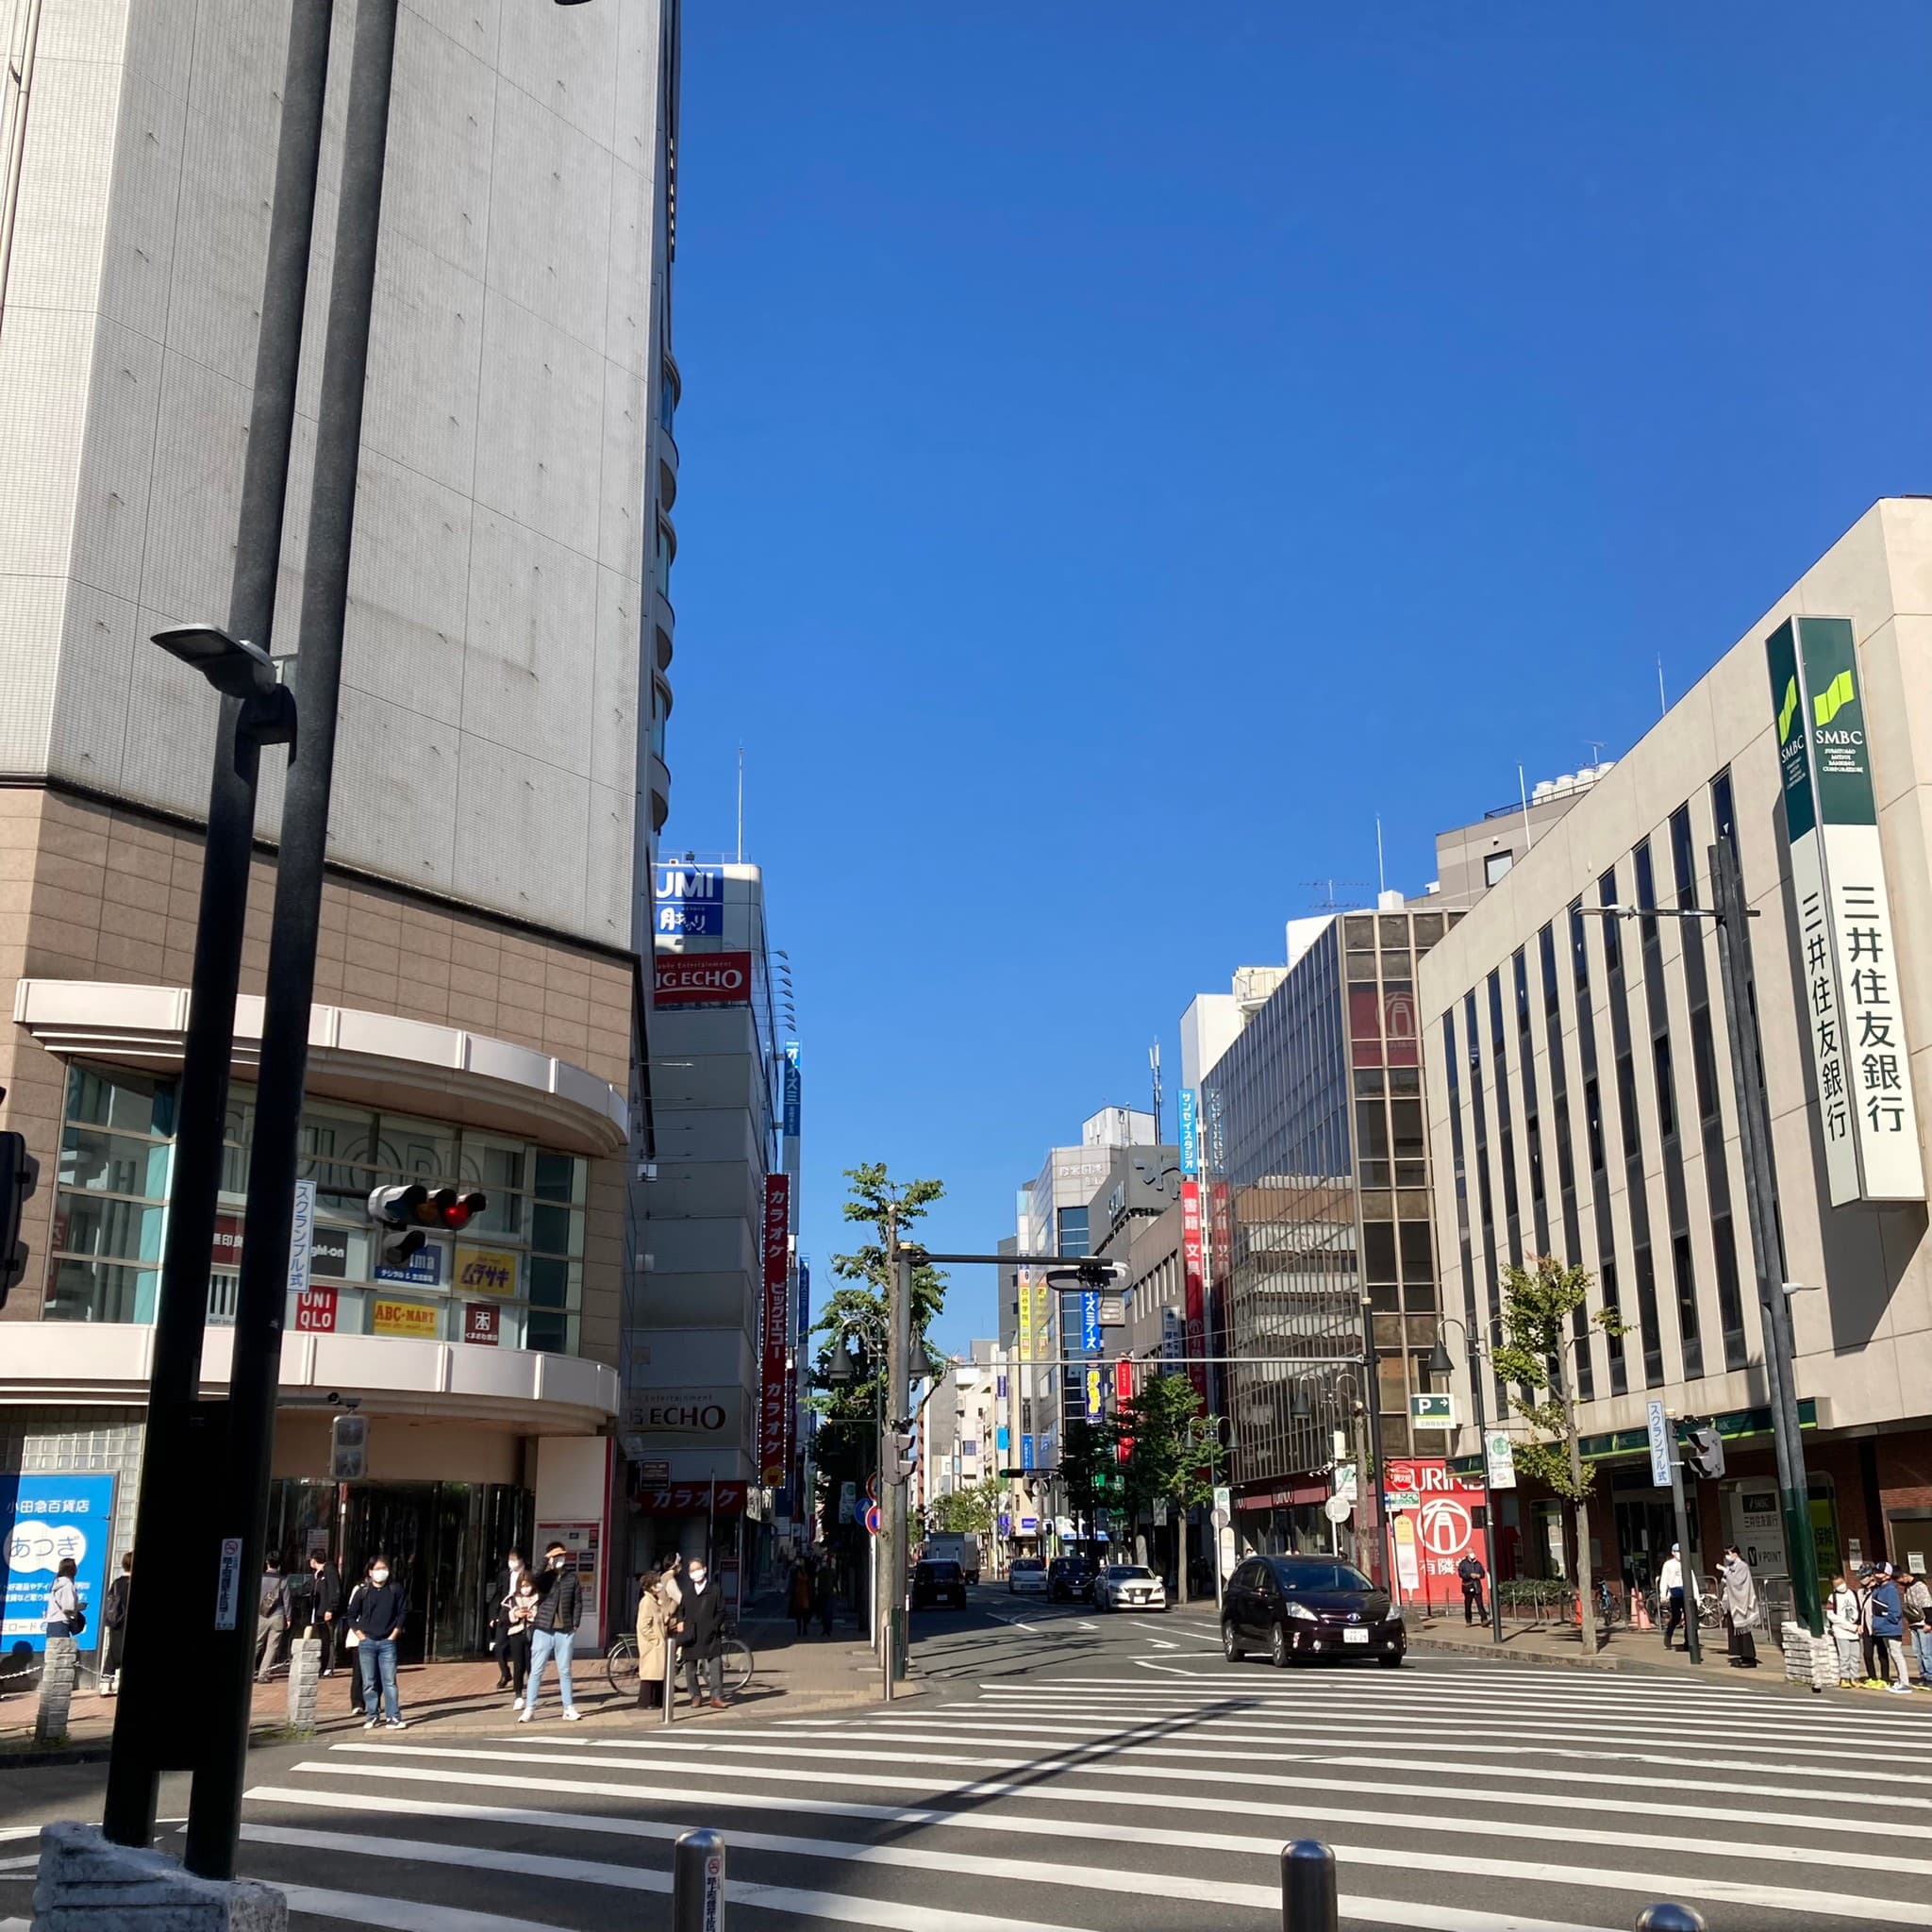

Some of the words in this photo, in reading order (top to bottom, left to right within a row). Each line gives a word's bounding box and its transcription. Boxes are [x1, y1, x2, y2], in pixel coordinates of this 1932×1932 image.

[1815, 729, 1863, 745] SMBC
[1781, 734, 1805, 763] SMBC
[655, 972, 677, 989] IG
[681, 969, 743, 989] ECHO
[1803, 892, 1847, 1141] 三井住友銀行
[1841, 886, 1906, 1134] 三井住友銀行
[1181, 1092, 1194, 1170] サンセイスタジオ
[768, 1190, 785, 1259] カラオケ
[212, 1232, 244, 1248] 無印良
[311, 1244, 345, 1258] ght-on
[1185, 1242, 1201, 1276] 文具
[301, 1292, 331, 1308] UNI
[300, 1312, 332, 1329] QLO
[375, 1305, 435, 1324] ABC-MART
[769, 1281, 786, 1359] ビッグエコー
[1418, 1398, 1432, 1415] P
[649, 1405, 726, 1430] ECHO
[764, 1382, 782, 1455] カラオケ
[7, 1499, 91, 1513] 小田急百貨店
[651, 1488, 739, 1508] カラオケ
[10, 1535, 80, 1557] あつぎ
[1419, 1557, 1459, 1576] 有隣
